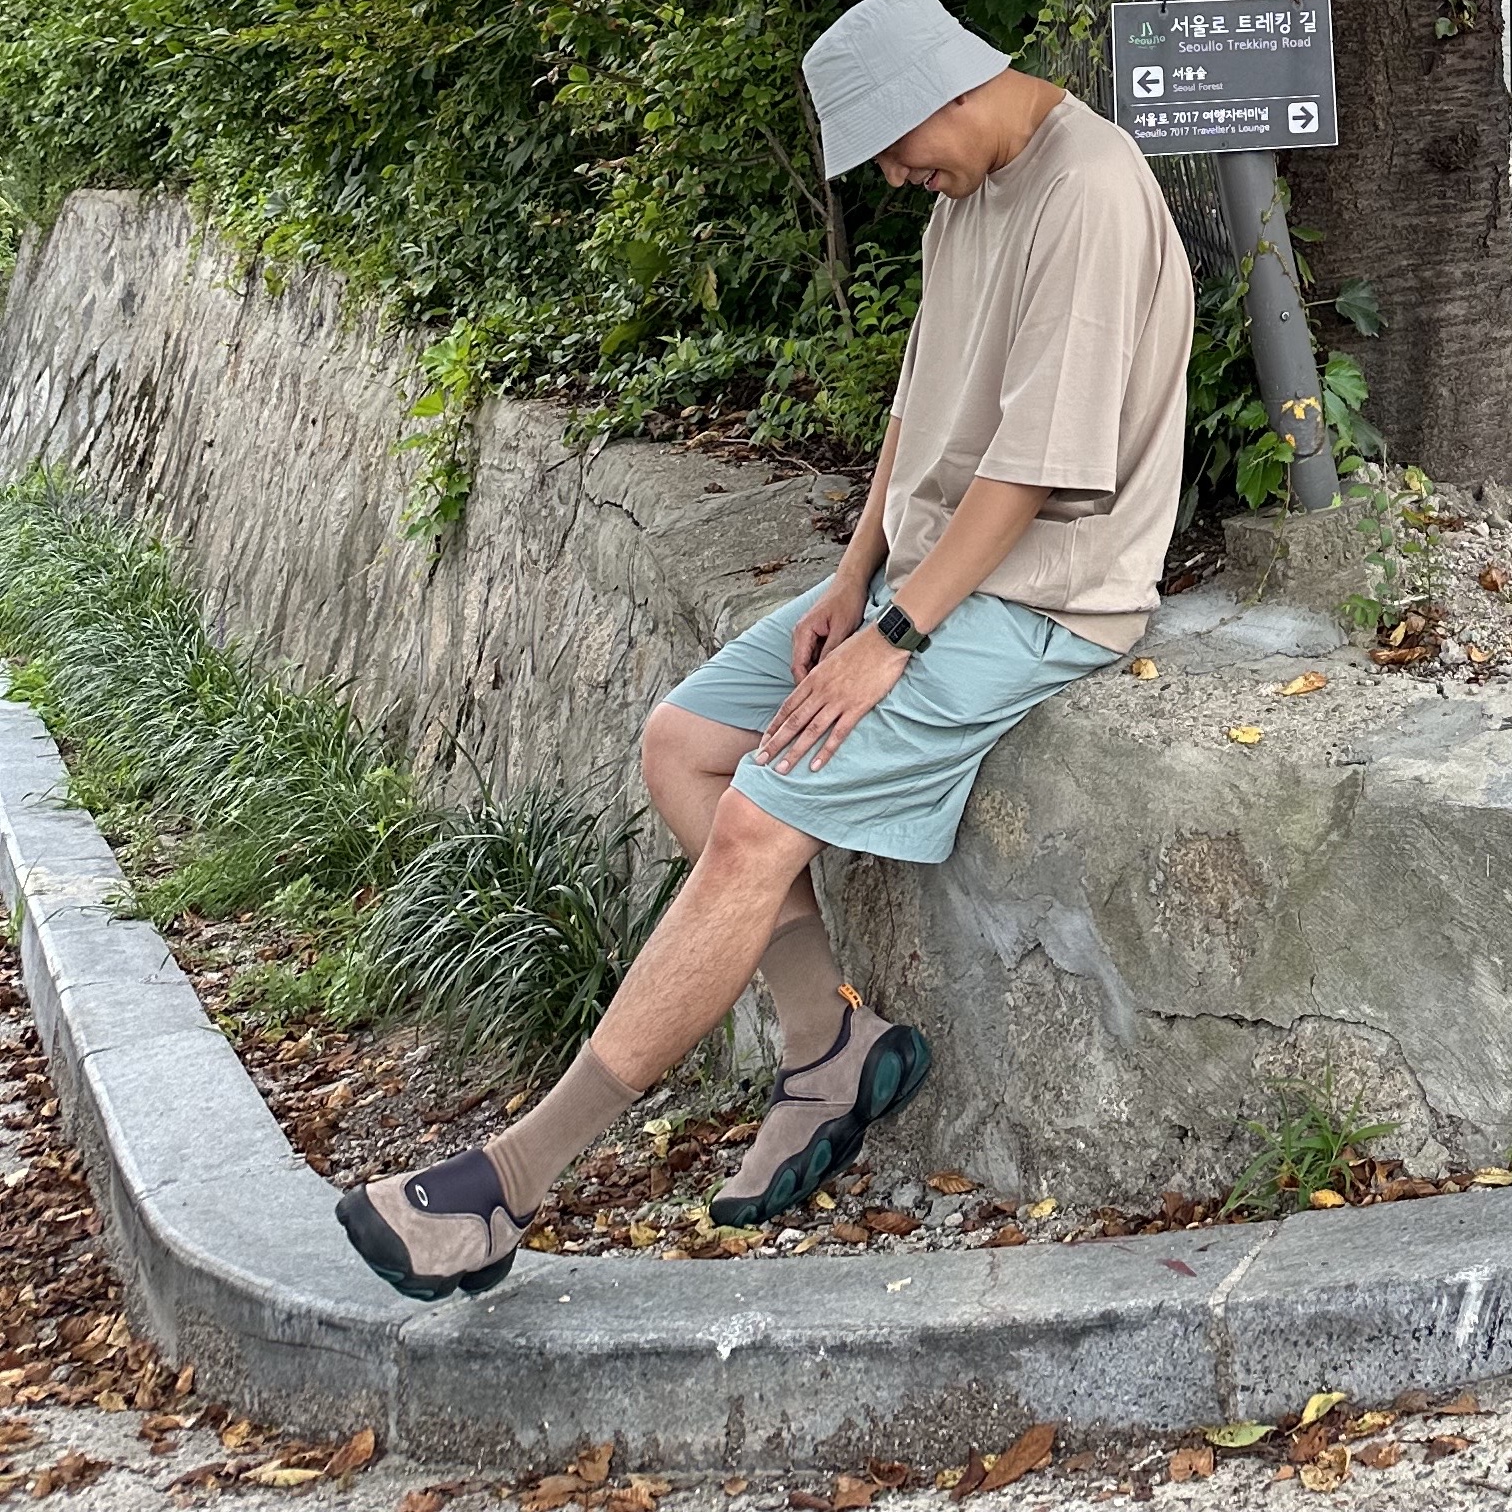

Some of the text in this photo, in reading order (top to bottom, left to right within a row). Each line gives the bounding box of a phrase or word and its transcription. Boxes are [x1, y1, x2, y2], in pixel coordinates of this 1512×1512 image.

[1170, 10, 1317, 38] 서울로 트레킹 길
[1178, 36, 1312, 53] Seoullo Trekking Road
[1172, 66, 1208, 81] 서울숲
[1172, 82, 1224, 93] Seoul Forest
[1134, 107, 1269, 127] 서울로 7017 여행자터미널
[1134, 129, 1168, 139] Seoullo
[1170, 126, 1190, 136] 7017
[1238, 123, 1270, 134] Lounge
